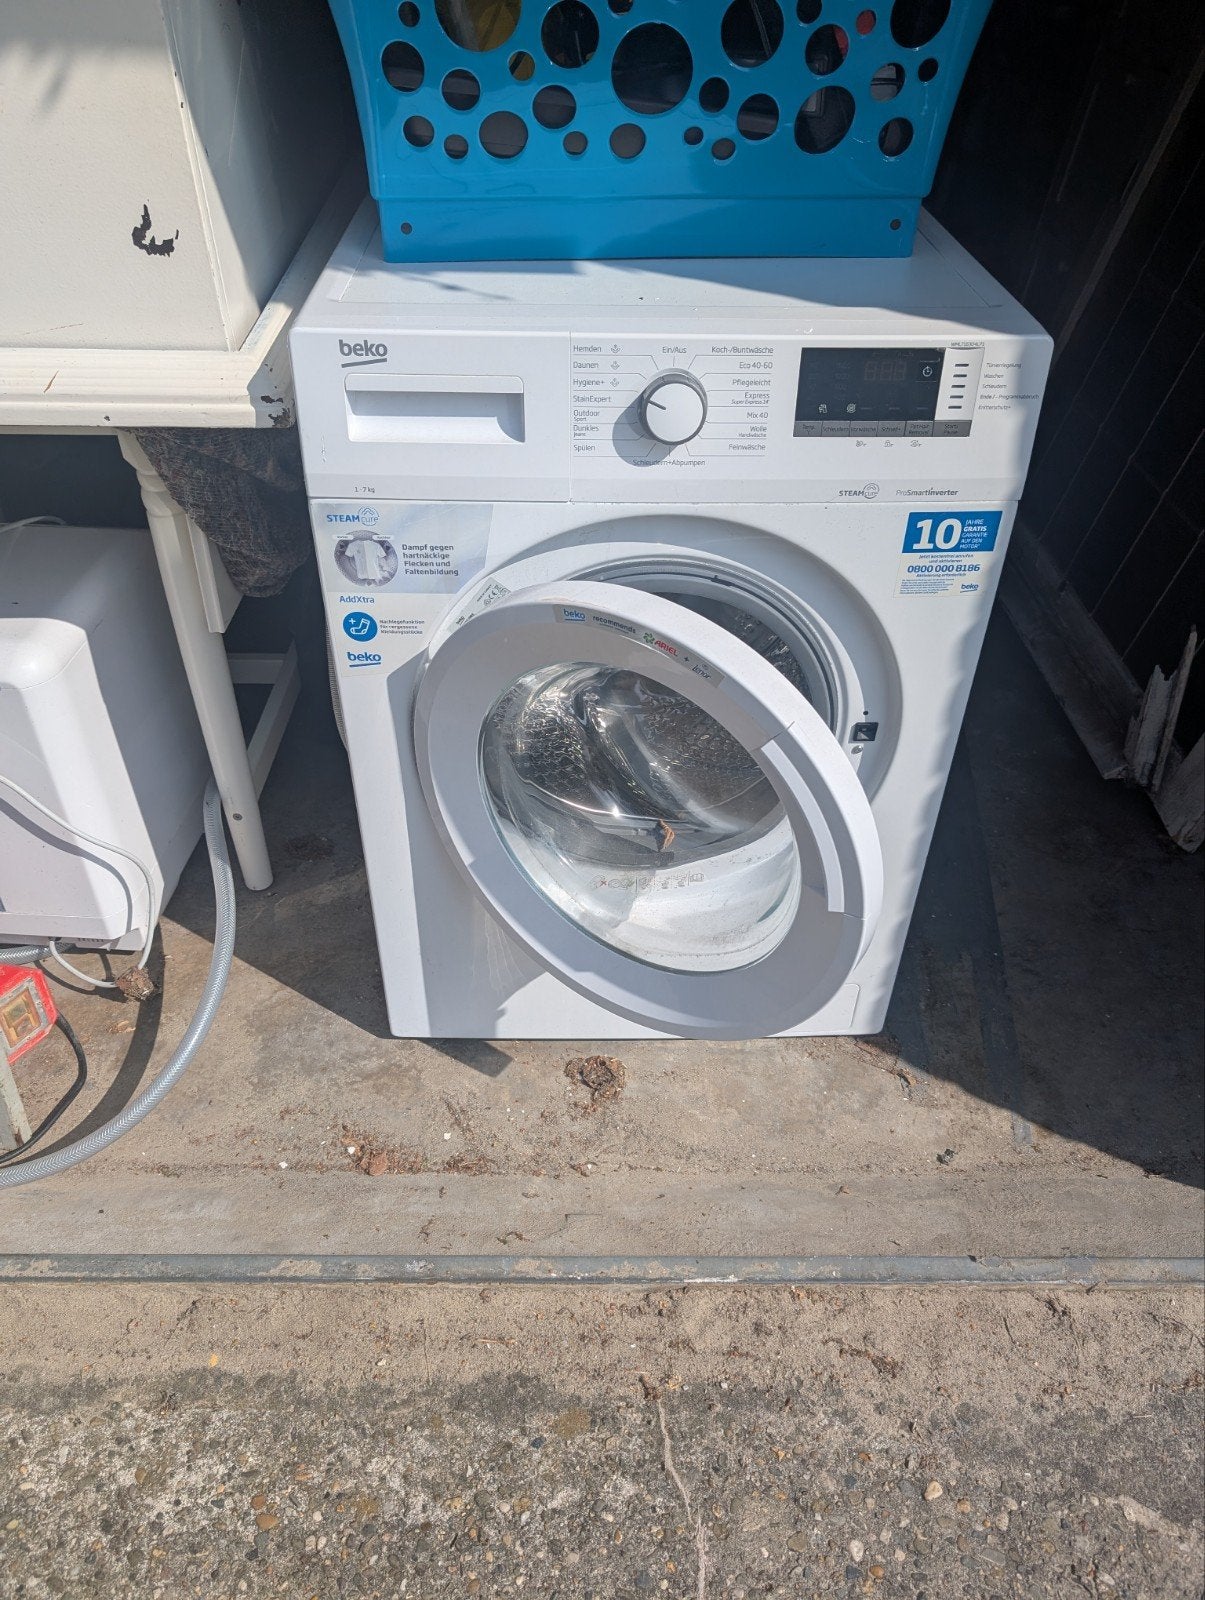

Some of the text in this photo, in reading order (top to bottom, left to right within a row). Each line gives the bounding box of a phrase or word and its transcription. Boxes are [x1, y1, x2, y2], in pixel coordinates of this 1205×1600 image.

[338, 339, 388, 358] beko
[573, 344, 602, 353] Hemden
[662, 346, 687, 354] Ein/Aus
[573, 361, 599, 369] Daunen
[573, 378, 606, 388] Hygiene+
[733, 379, 771, 388] Pflegeleicht
[573, 395, 612, 404] StainExpert
[744, 392, 770, 401] Express
[574, 424, 600, 432] Dunkles
[912, 518, 962, 550] 10
[402, 544, 454, 554] Dampf gegen
[403, 552, 450, 561] hartnäckige
[404, 560, 450, 568] Flecken und
[907, 564, 981, 573] 0800 000 8186
[405, 568, 459, 577] Faltenbildung
[339, 595, 375, 604] AddXtra
[563, 608, 586, 620] beko
[592, 615, 636, 634] recommends
[654, 640, 679, 657] ARIEL
[347, 652, 382, 662] beko
